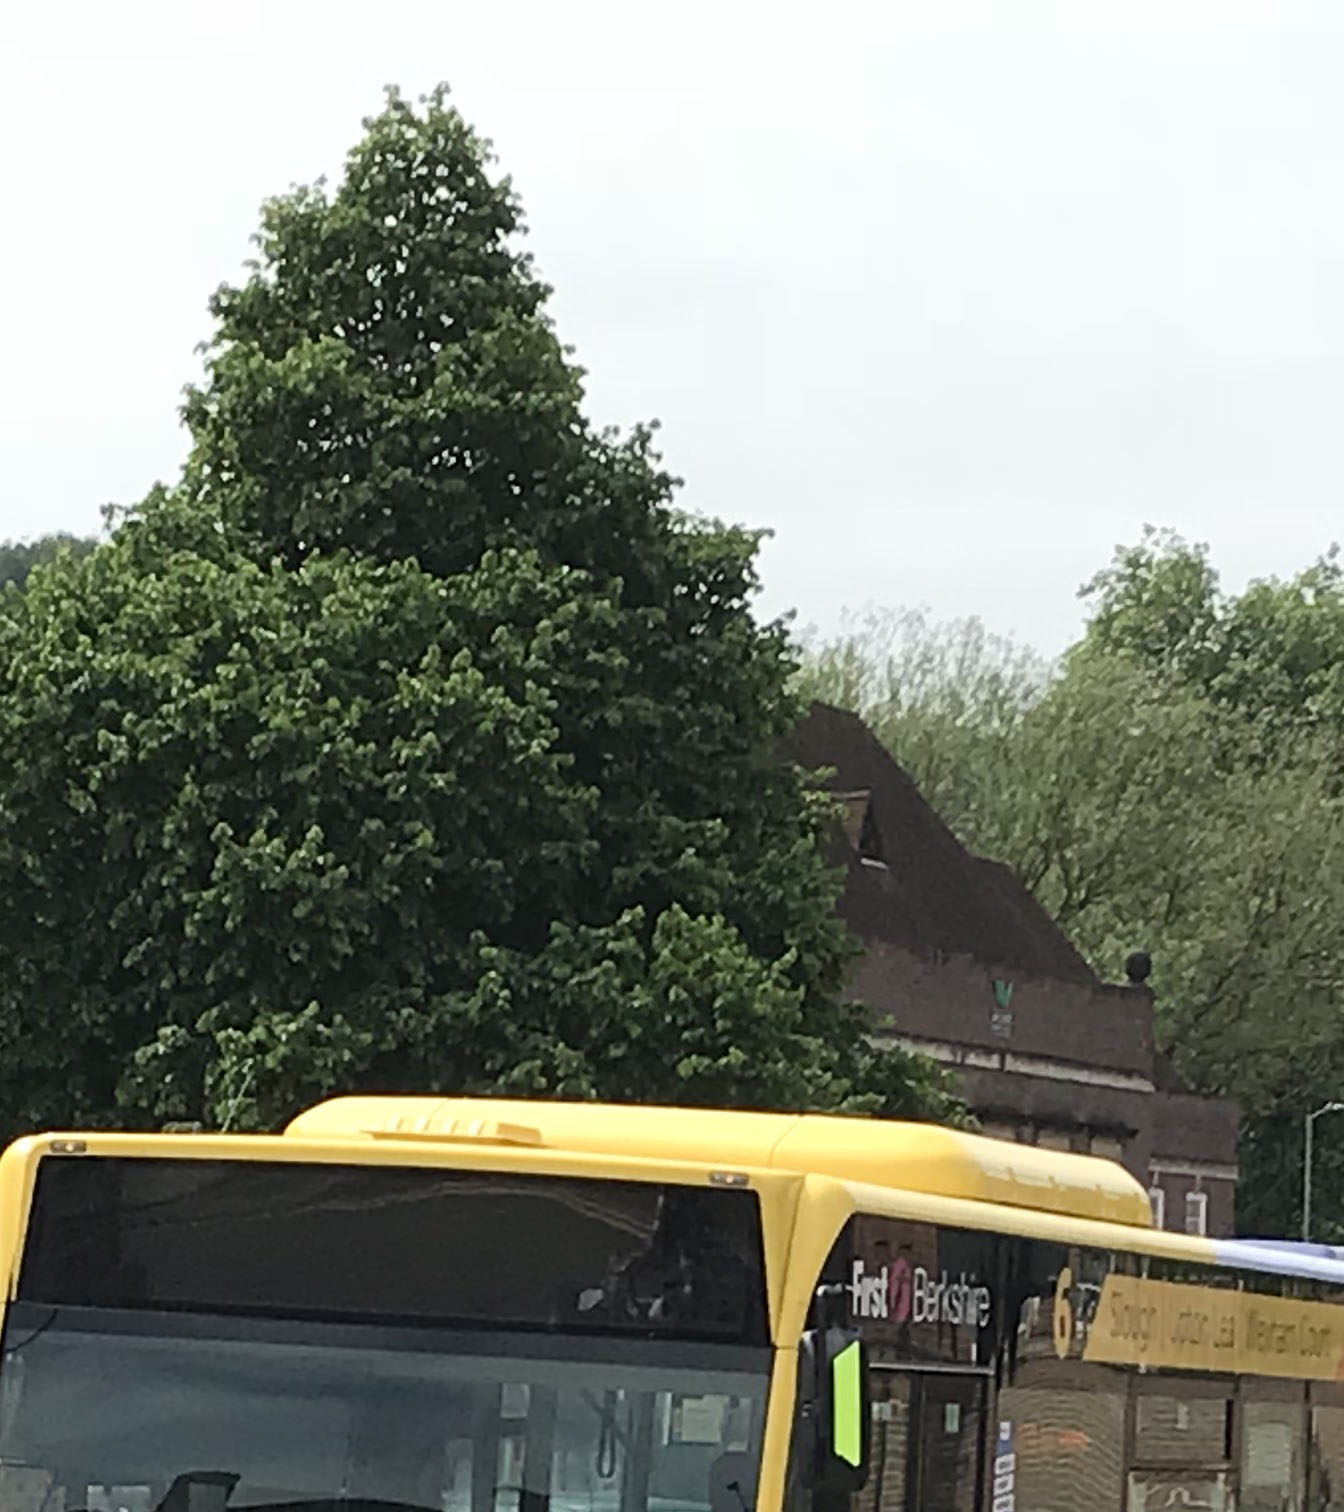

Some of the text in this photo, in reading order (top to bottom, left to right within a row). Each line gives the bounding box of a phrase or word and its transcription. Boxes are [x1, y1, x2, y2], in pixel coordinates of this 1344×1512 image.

[852, 1260, 990, 1327] First Berkshire
[1053, 1267, 1072, 1359] 6
